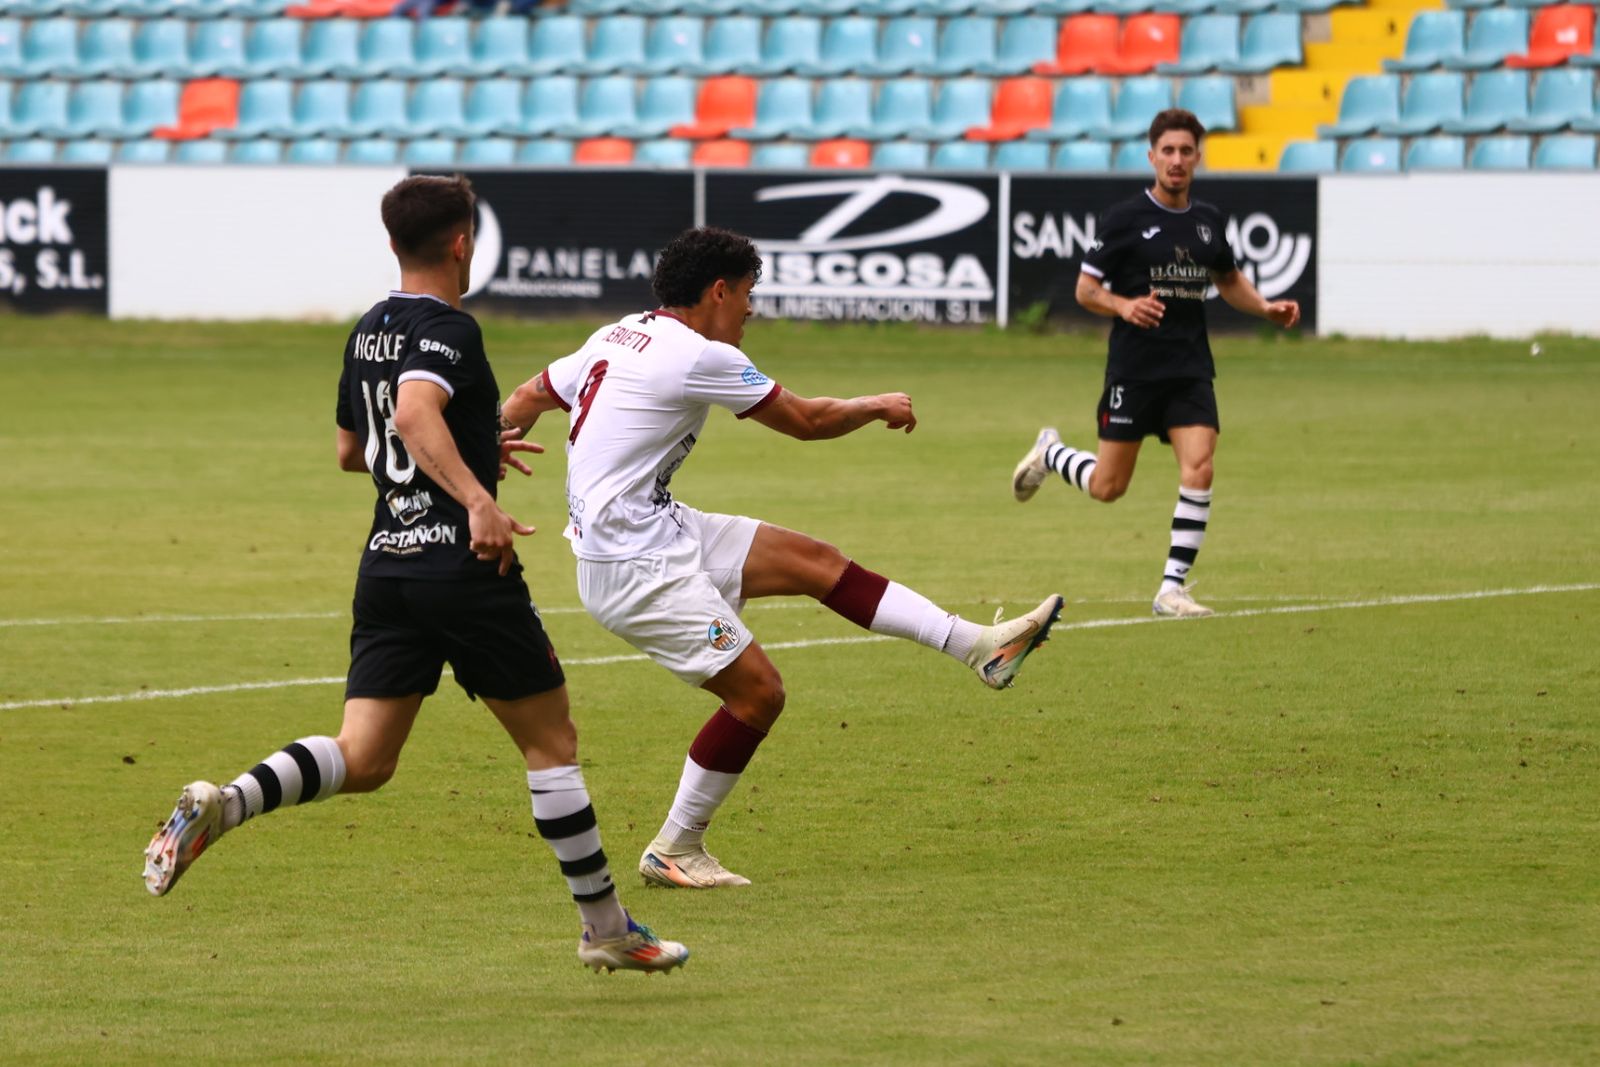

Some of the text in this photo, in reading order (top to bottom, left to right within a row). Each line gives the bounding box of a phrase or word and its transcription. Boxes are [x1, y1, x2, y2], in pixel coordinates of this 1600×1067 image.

[0, 186, 73, 243] ck
[36, 247, 103, 288] S.L.
[507, 247, 664, 281] PANELA
[757, 252, 992, 288] ISCOSA
[568, 359, 609, 446] 9
[1109, 385, 1125, 409] 15
